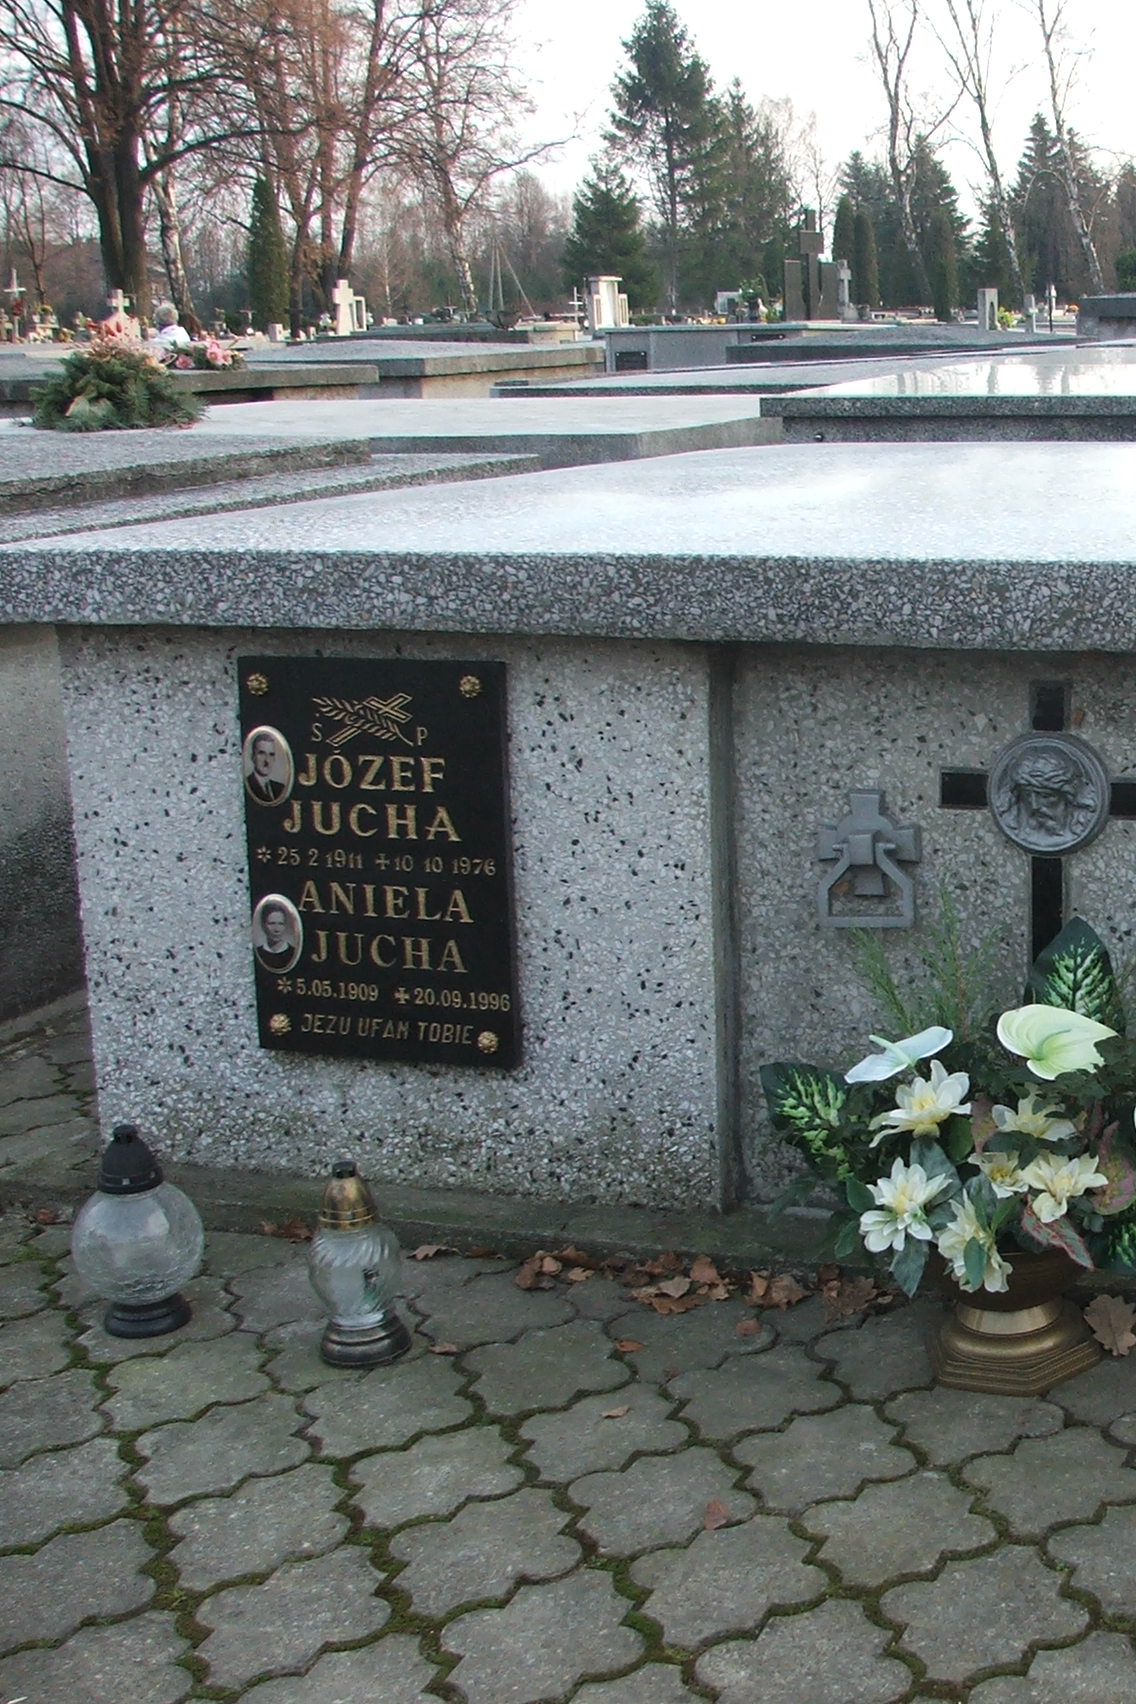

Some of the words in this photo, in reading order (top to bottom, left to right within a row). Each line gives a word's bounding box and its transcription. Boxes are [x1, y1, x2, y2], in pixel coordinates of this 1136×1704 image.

[416, 726, 429, 746] P
[297, 750, 446, 793] JÓZEF
[283, 799, 463, 843] JUCHA
[452, 857, 497, 877] 1976
[298, 880, 475, 924] ANIELA
[311, 929, 469, 974] JUCHA
[296, 977, 379, 1002] 5.05.1909
[413, 987, 512, 1013] 20.09.1996
[300, 1013, 351, 1036] JEZU
[357, 1017, 410, 1041] UFAM
[417, 1021, 475, 1046] TOBIE
